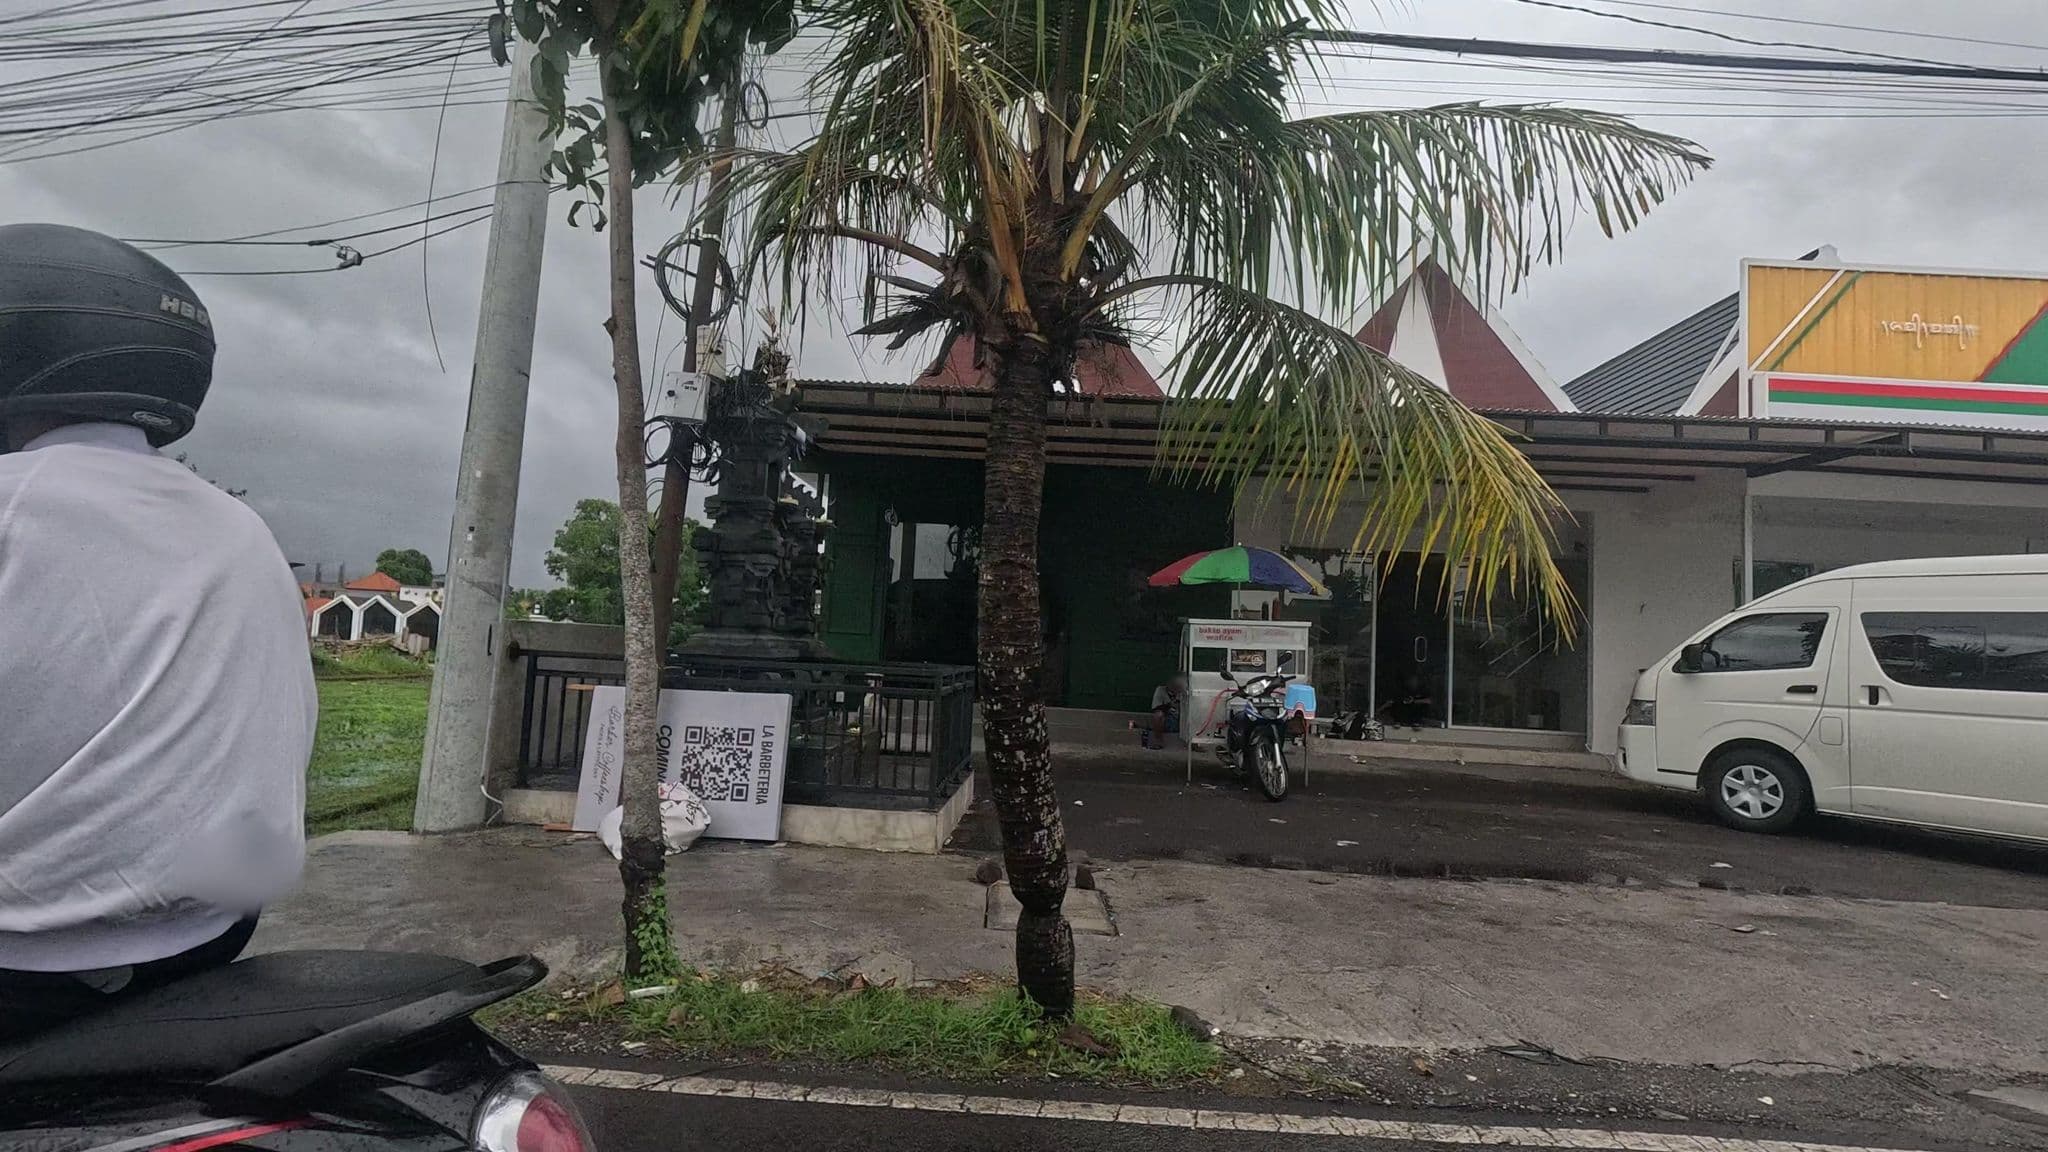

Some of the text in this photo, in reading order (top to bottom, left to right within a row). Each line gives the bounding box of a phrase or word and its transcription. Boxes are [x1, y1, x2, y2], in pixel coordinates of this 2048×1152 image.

[656, 725, 672, 783] COMIN
[755, 725, 775, 805] LA BARBETERIA
